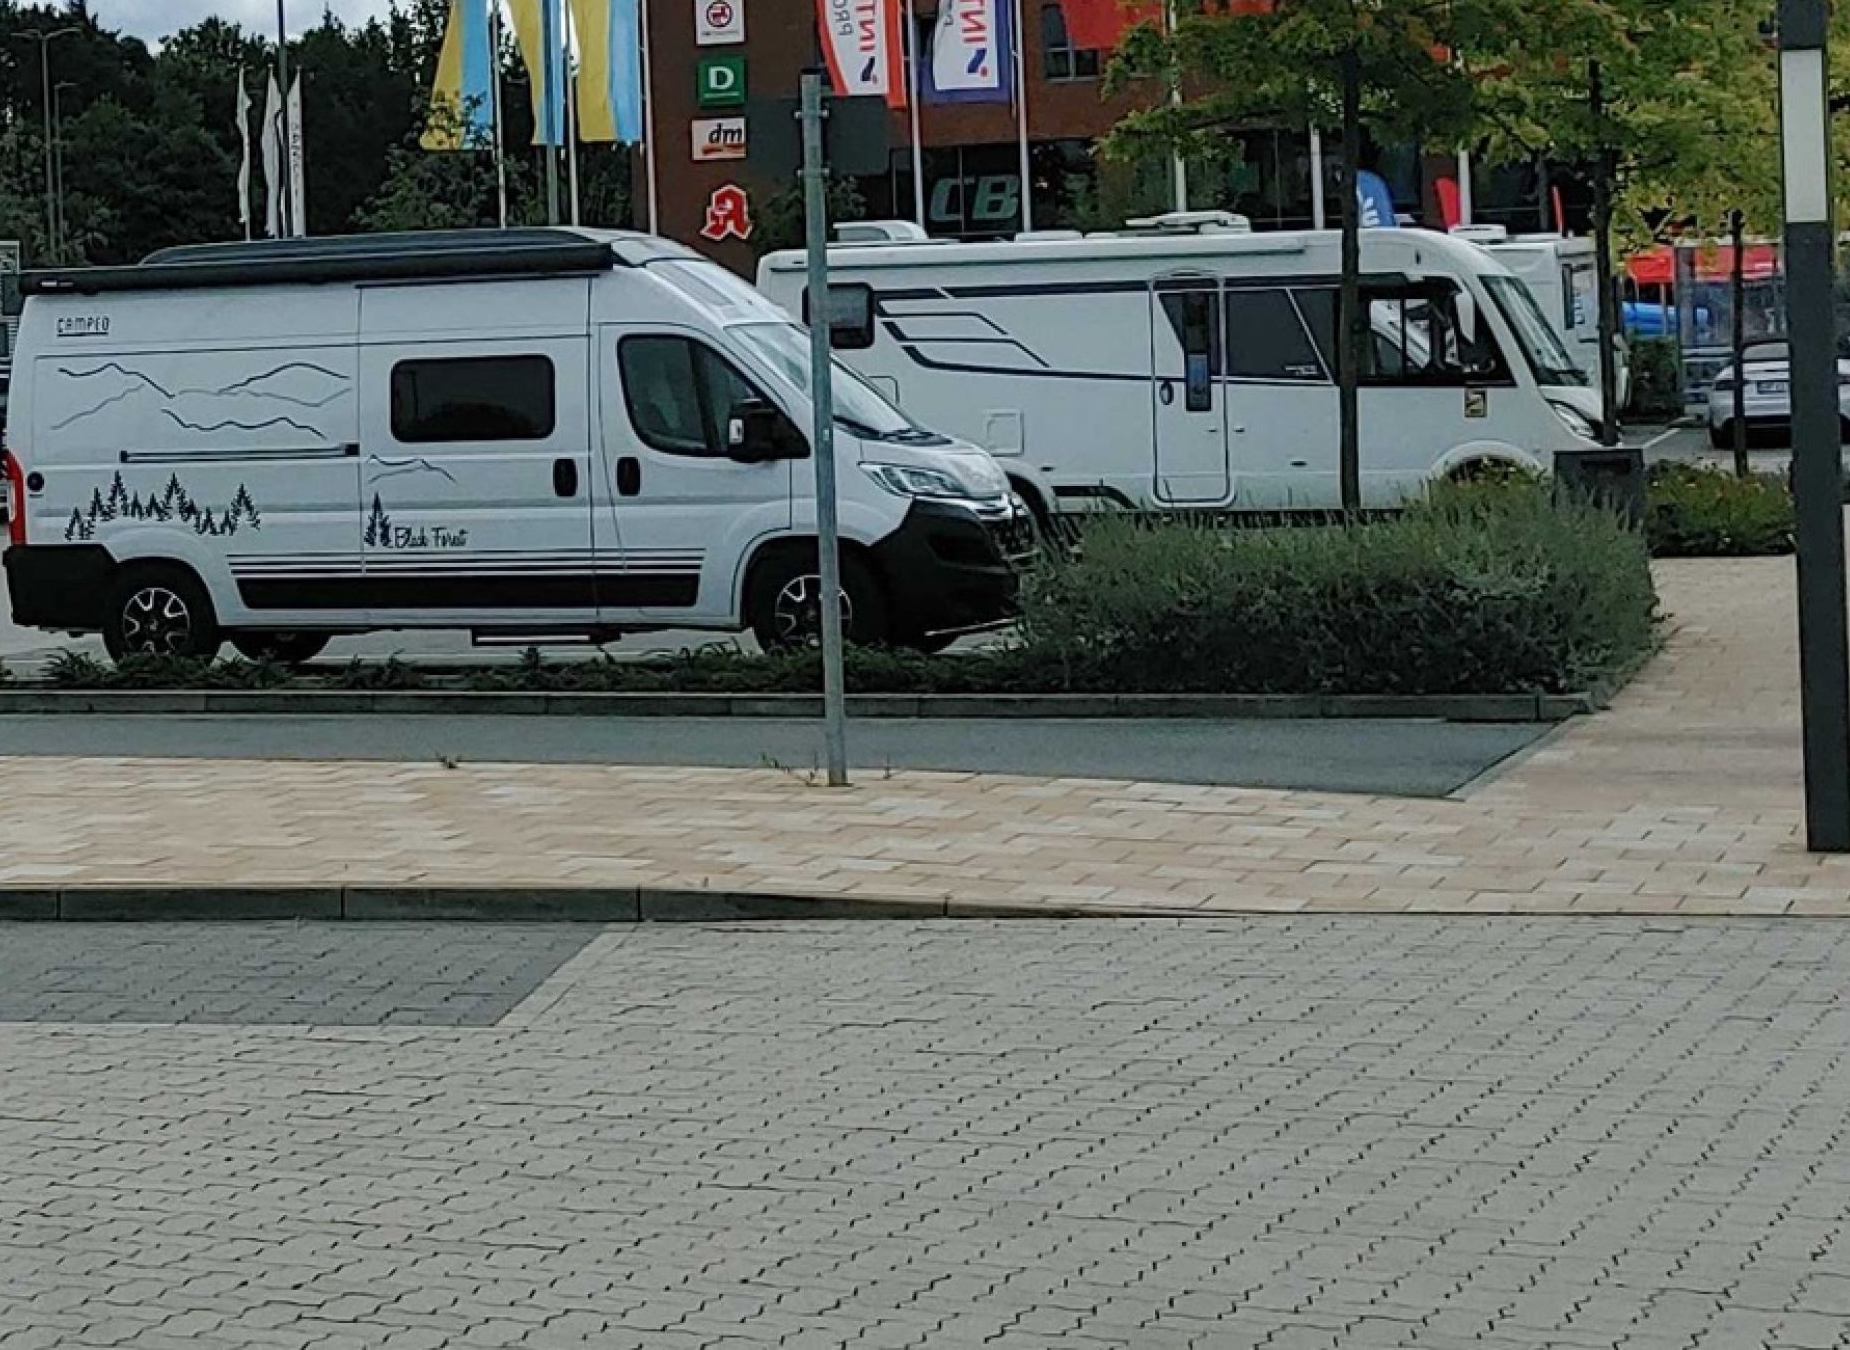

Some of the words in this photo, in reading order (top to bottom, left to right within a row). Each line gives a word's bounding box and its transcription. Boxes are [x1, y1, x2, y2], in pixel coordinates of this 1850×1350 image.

[708, 66, 735, 90] D
[708, 122, 743, 144] dm
[929, 174, 1020, 222] CB
